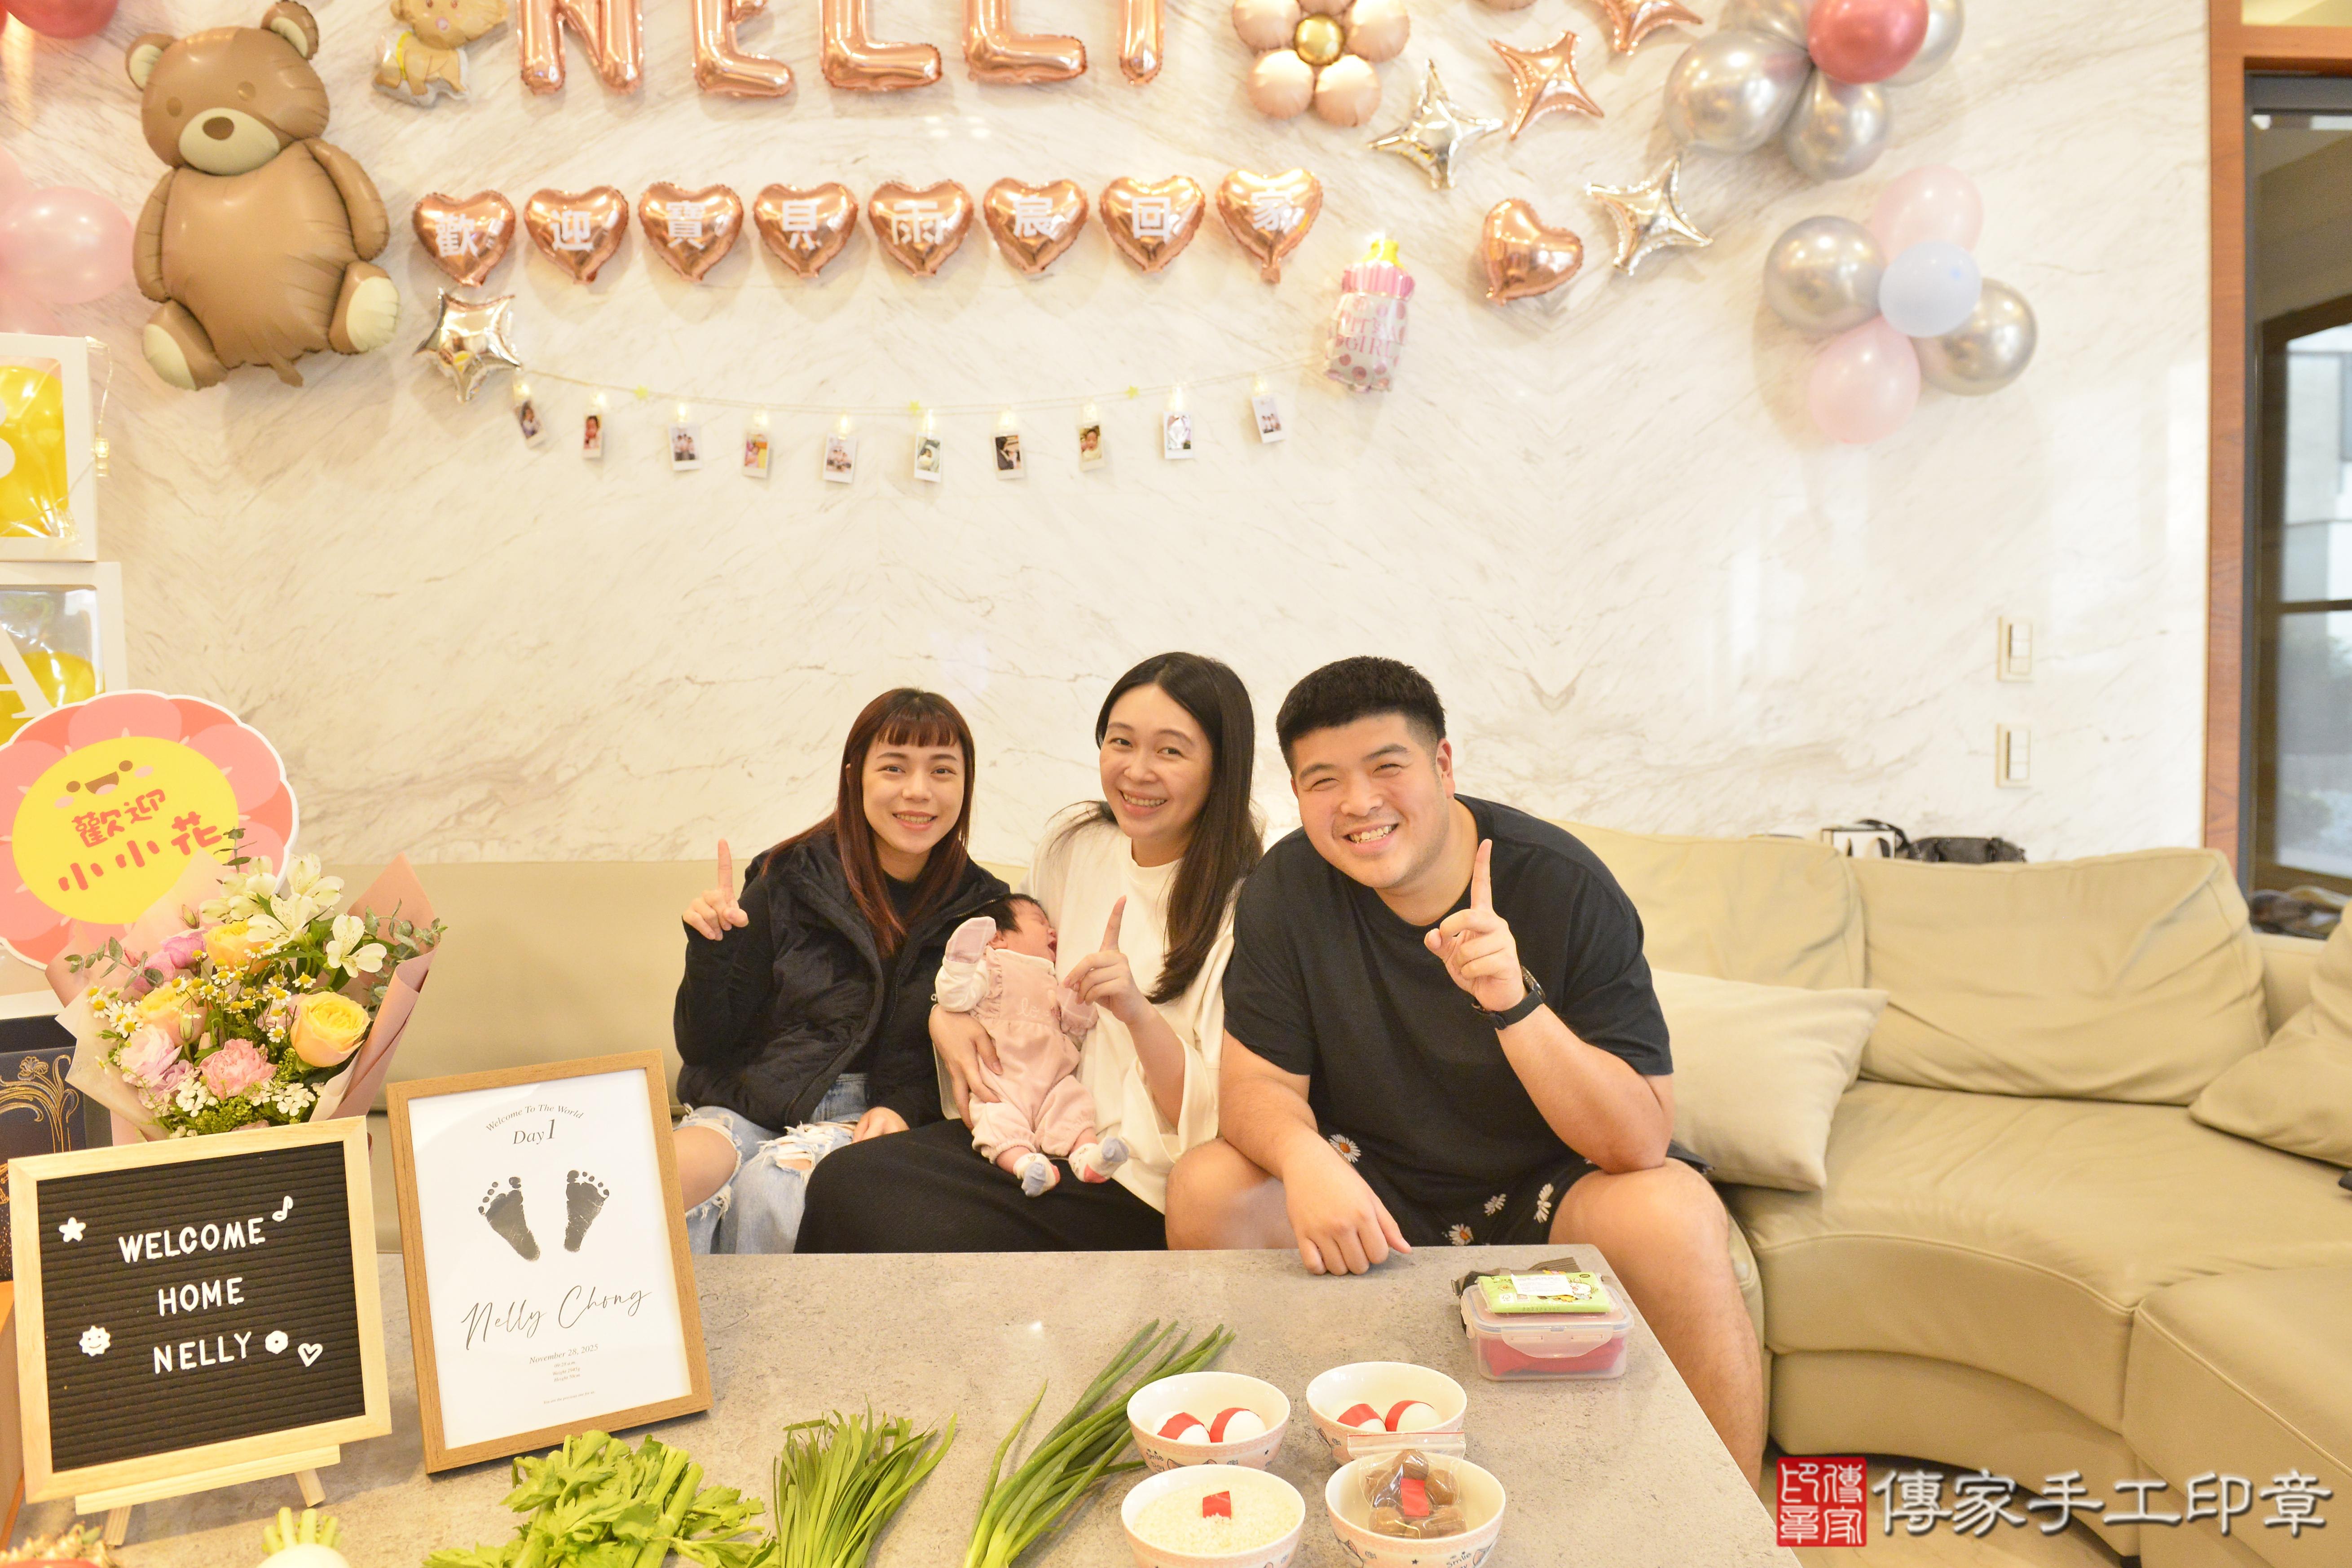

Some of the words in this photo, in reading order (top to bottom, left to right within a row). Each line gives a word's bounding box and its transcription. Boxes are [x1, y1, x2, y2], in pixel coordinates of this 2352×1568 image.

[1346, 335, 1396, 358] GIRL
[72, 788, 166, 848] 歡迎
[58, 811, 222, 892] 小小花
[485, 1110, 523, 1132] Welcome
[524, 1105, 535, 1114] To
[558, 1105, 584, 1119] World
[118, 1217, 265, 1263] WELCOME
[158, 1277, 244, 1317] HOME
[461, 1299, 547, 1350] Nelly
[558, 1285, 652, 1329] Chong
[153, 1331, 252, 1374] NELLY
[529, 1352, 566, 1364] November
[568, 1348, 579, 1357] 28,
[581, 1343, 599, 1354] 2025
